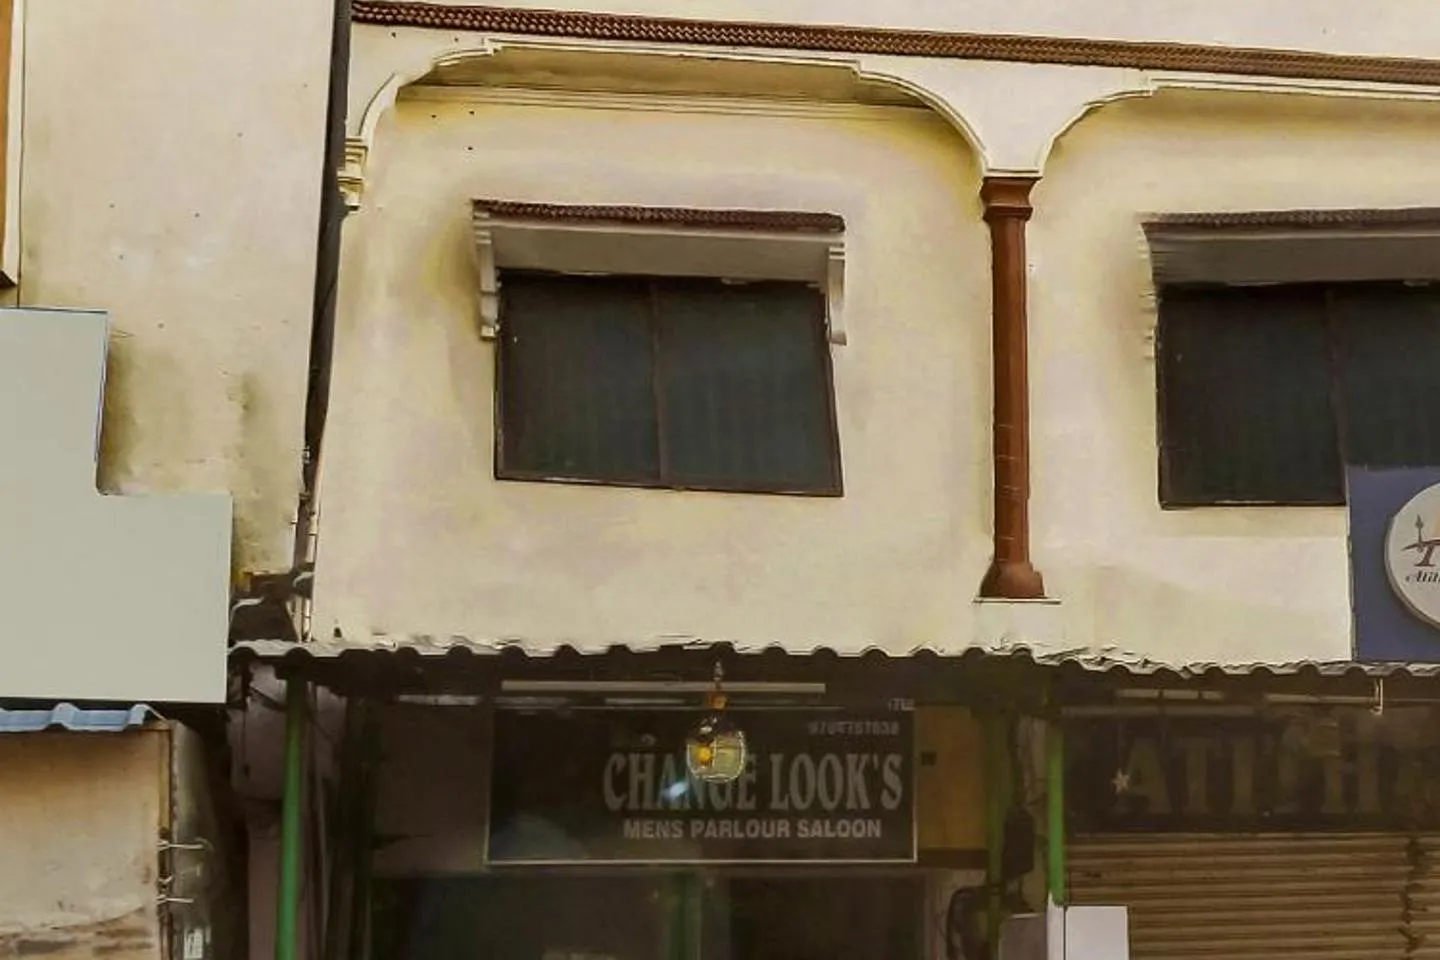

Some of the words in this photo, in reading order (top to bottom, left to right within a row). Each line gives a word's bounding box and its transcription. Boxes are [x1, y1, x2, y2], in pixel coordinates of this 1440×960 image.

[769, 751, 904, 811] LOOK'S
[623, 818, 684, 839] MENS
[690, 818, 791, 839] PARLOUR
[797, 818, 882, 838] SALOON
